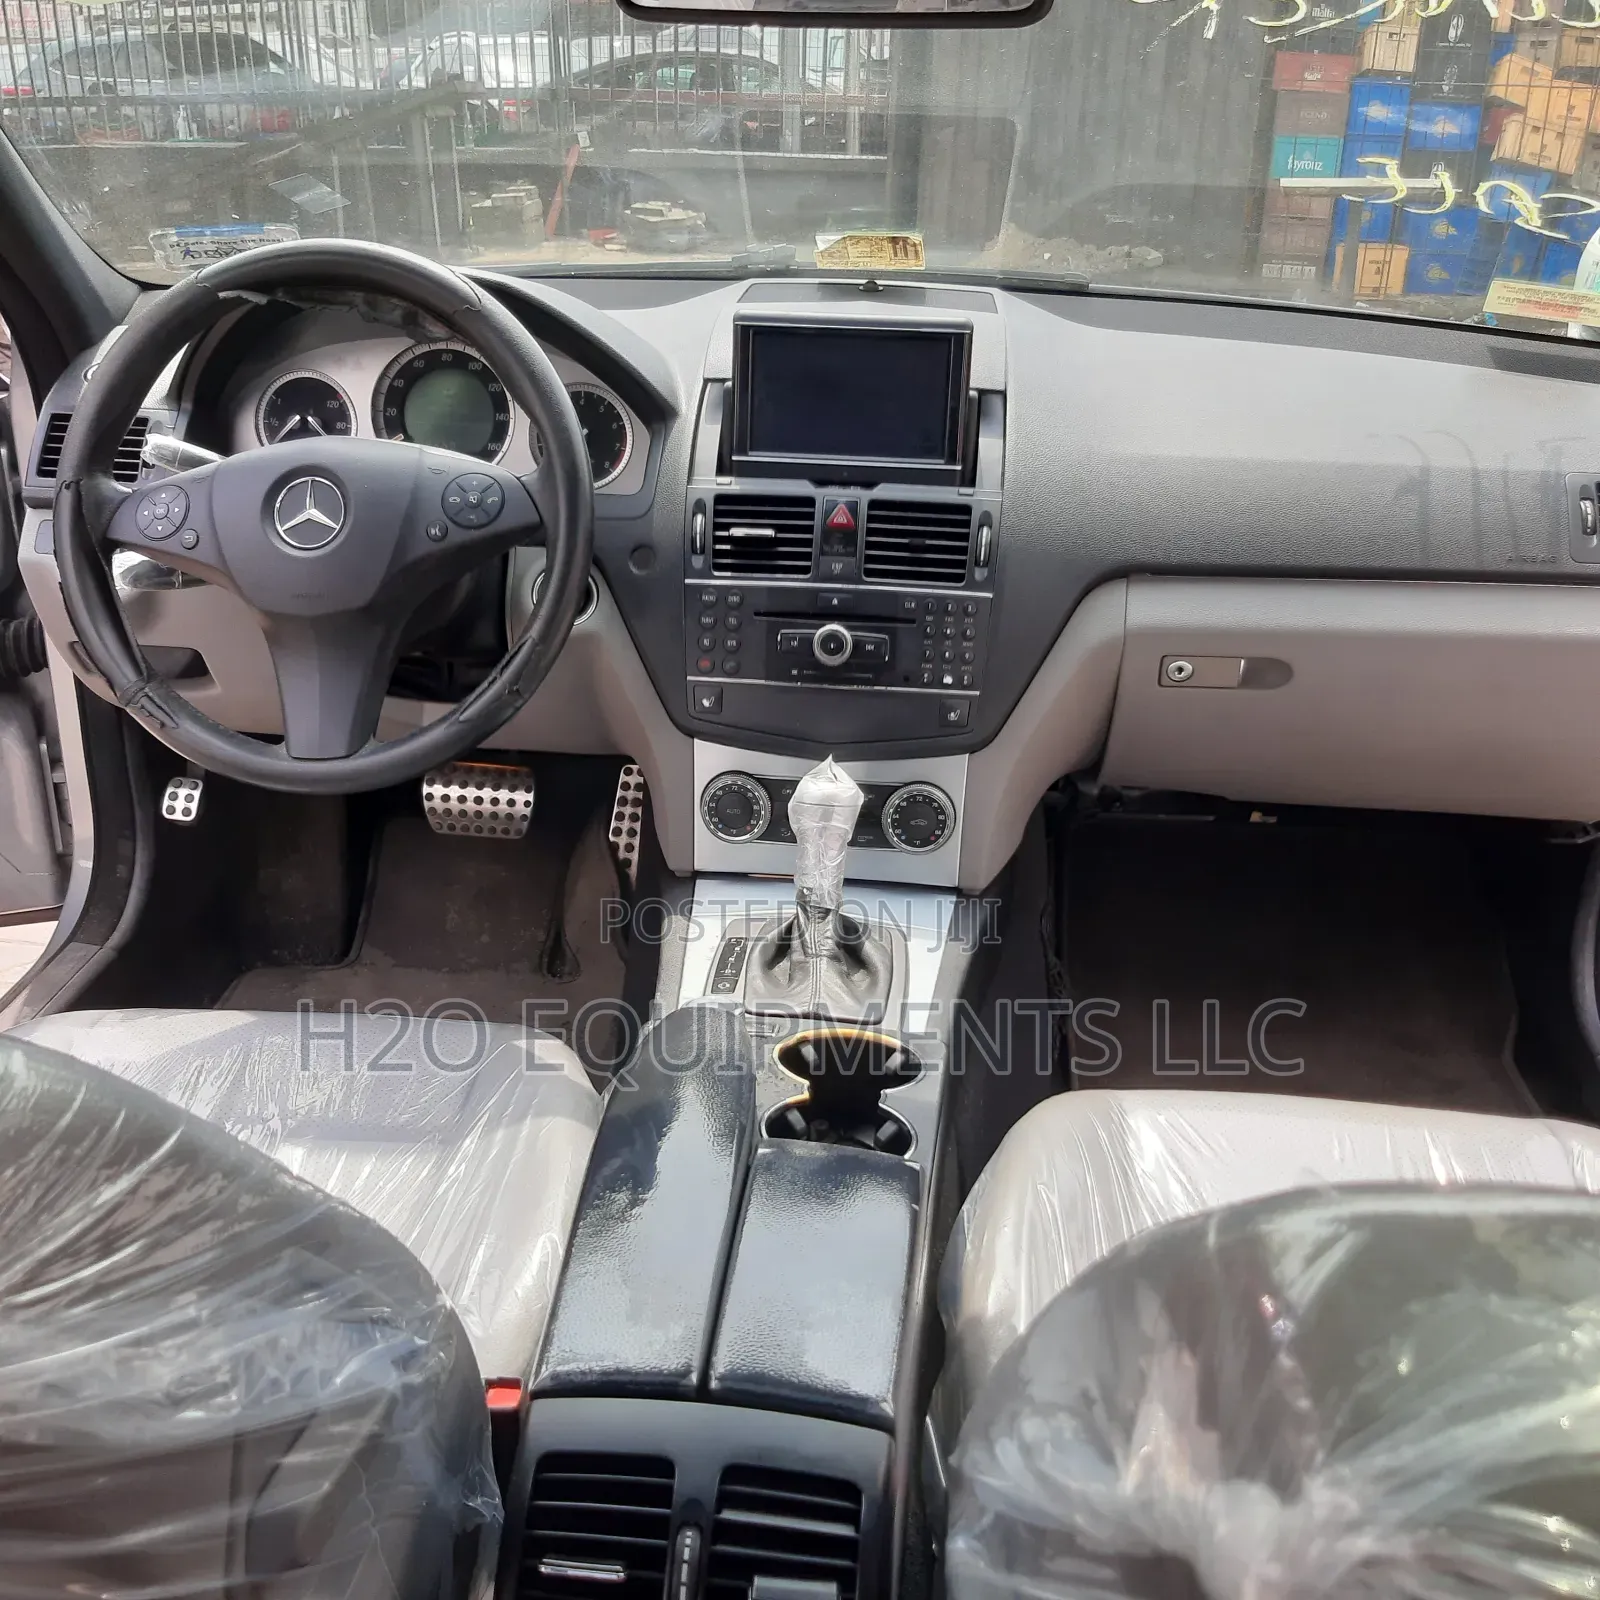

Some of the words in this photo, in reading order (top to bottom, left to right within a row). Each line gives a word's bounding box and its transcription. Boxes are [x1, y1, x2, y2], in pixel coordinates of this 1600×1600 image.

[441, 353, 452, 361] 80
[413, 360, 425, 368] 60
[468, 361, 482, 370] 100
[392, 379, 404, 387] 40
[488, 383, 501, 392] 120
[326, 401, 340, 409] 120
[385, 408, 397, 416] 20
[495, 413, 509, 421] 140
[335, 421, 346, 429] 80
[487, 443, 501, 451] 160
